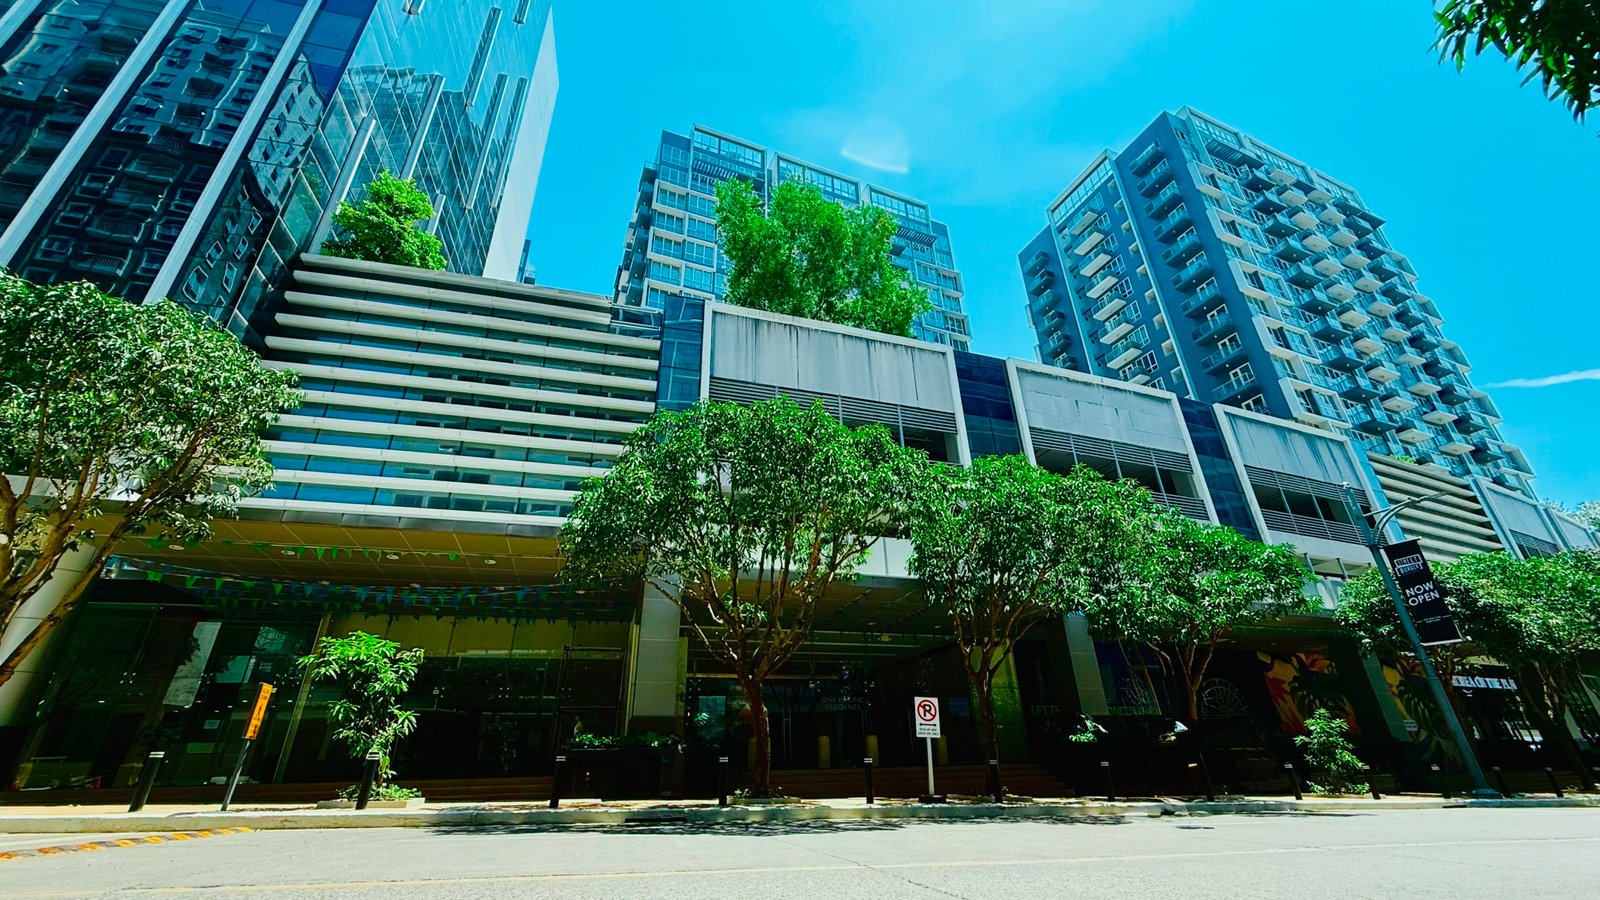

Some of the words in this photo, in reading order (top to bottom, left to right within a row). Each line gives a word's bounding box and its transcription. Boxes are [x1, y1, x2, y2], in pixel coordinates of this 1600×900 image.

[1397, 556, 1418, 566] STREET
[1400, 564, 1420, 574] BURGER
[1405, 581, 1434, 597] NOW
[1408, 590, 1440, 606] OPEN
